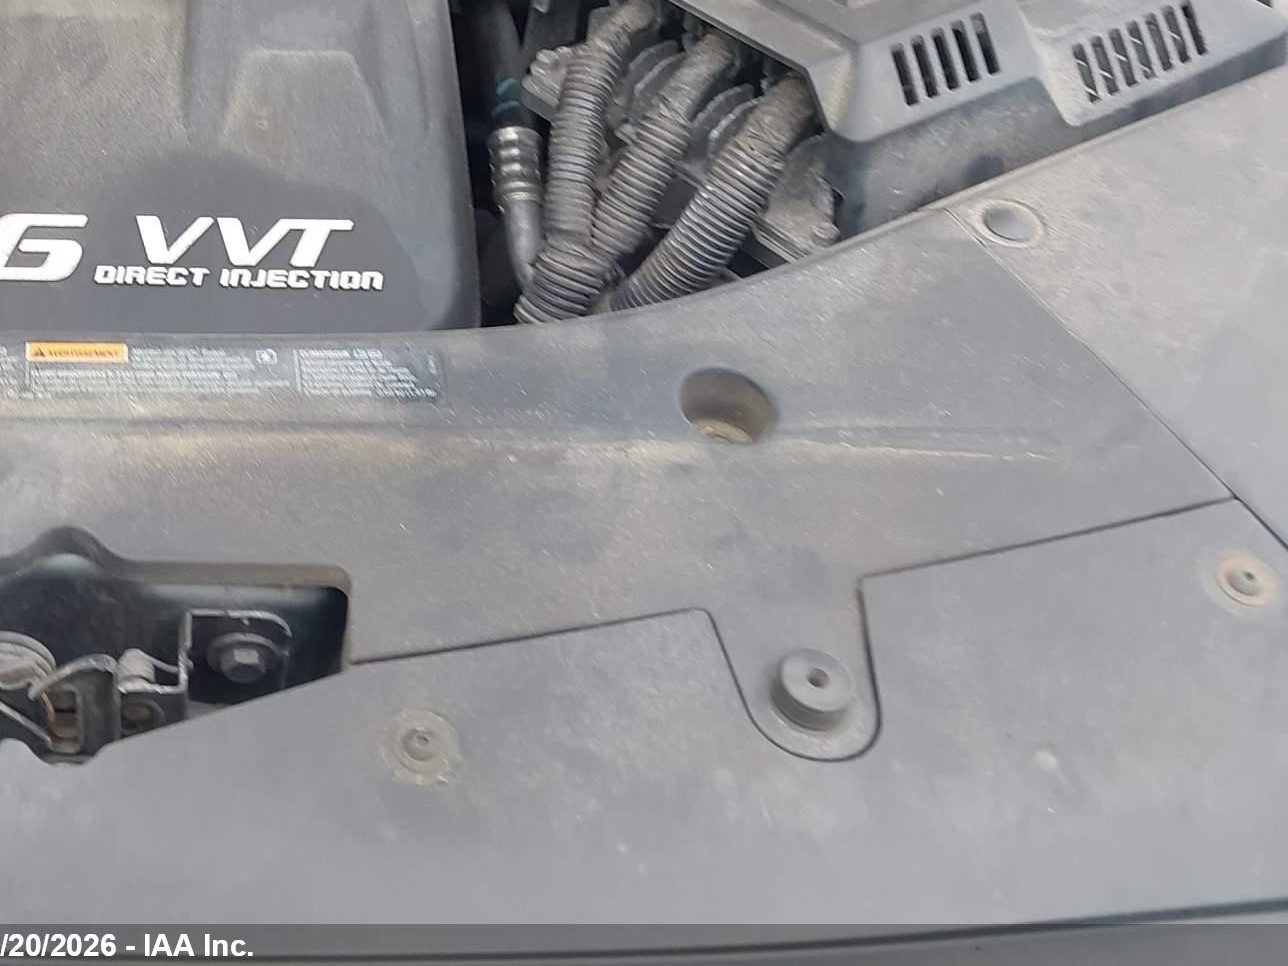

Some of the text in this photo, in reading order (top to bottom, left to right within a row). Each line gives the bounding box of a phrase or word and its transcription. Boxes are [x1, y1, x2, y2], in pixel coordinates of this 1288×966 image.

[135, 214, 354, 267] VVT
[93, 265, 385, 291] DIRECT INJECTION
